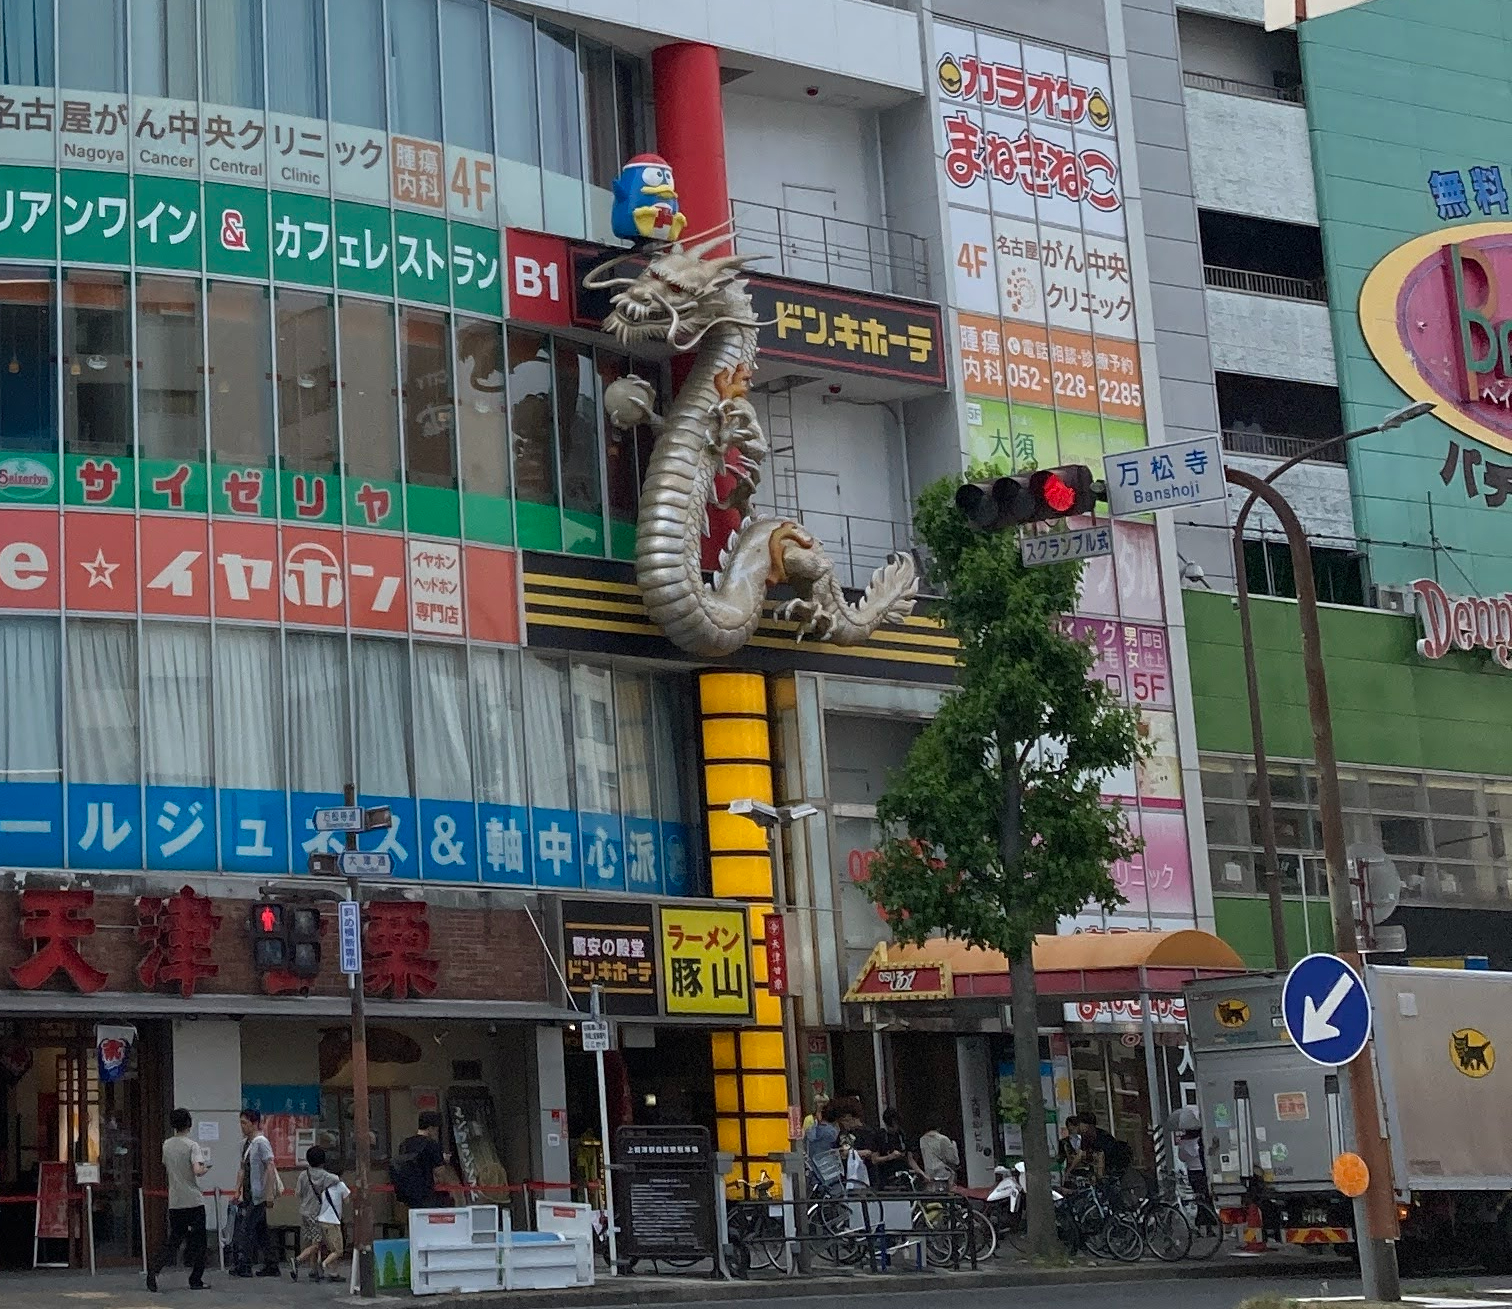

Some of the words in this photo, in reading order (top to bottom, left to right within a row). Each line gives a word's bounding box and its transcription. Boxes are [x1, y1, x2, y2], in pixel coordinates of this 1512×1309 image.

[958, 54, 1091, 124] カラオケ
[64, 142, 125, 163] Nagoya
[139, 149, 195, 169] Cancer
[210, 157, 263, 177] Central
[281, 166, 321, 186] Clinic
[396, 143, 440, 177] 腫瘍
[943, 110, 1122, 213] まねきねこ
[396, 173, 440, 203] 内科
[451, 156, 493, 212] 4F
[1428, 166, 1509, 221] 無料
[220, 208, 251, 253] &
[275, 215, 498, 290] カフェレストラン
[957, 242, 988, 279] 4F
[996, 234, 1129, 284] 名古屋がん中央
[514, 256, 560, 302] B1
[1046, 283, 1133, 322] クリニック
[960, 325, 1000, 356] 腫瘍
[963, 357, 1002, 386] 内科
[1007, 364, 1140, 407] 052-228-2285
[989, 428, 1038, 466] 大須
[1116, 449, 1209, 487] 万松寺
[77, 460, 390, 525] サイゼリヤ
[1134, 481, 1200, 504] Banshoji
[412, 551, 456, 570] イヤホン
[413, 575, 458, 596] ヘッドホン
[414, 600, 459, 626] 専門店
[1133, 672, 1165, 703] 5F
[572, 935, 646, 958] 驚安の殿堂
[667, 925, 740, 952] ラーメン
[671, 957, 743, 999] 豚山
